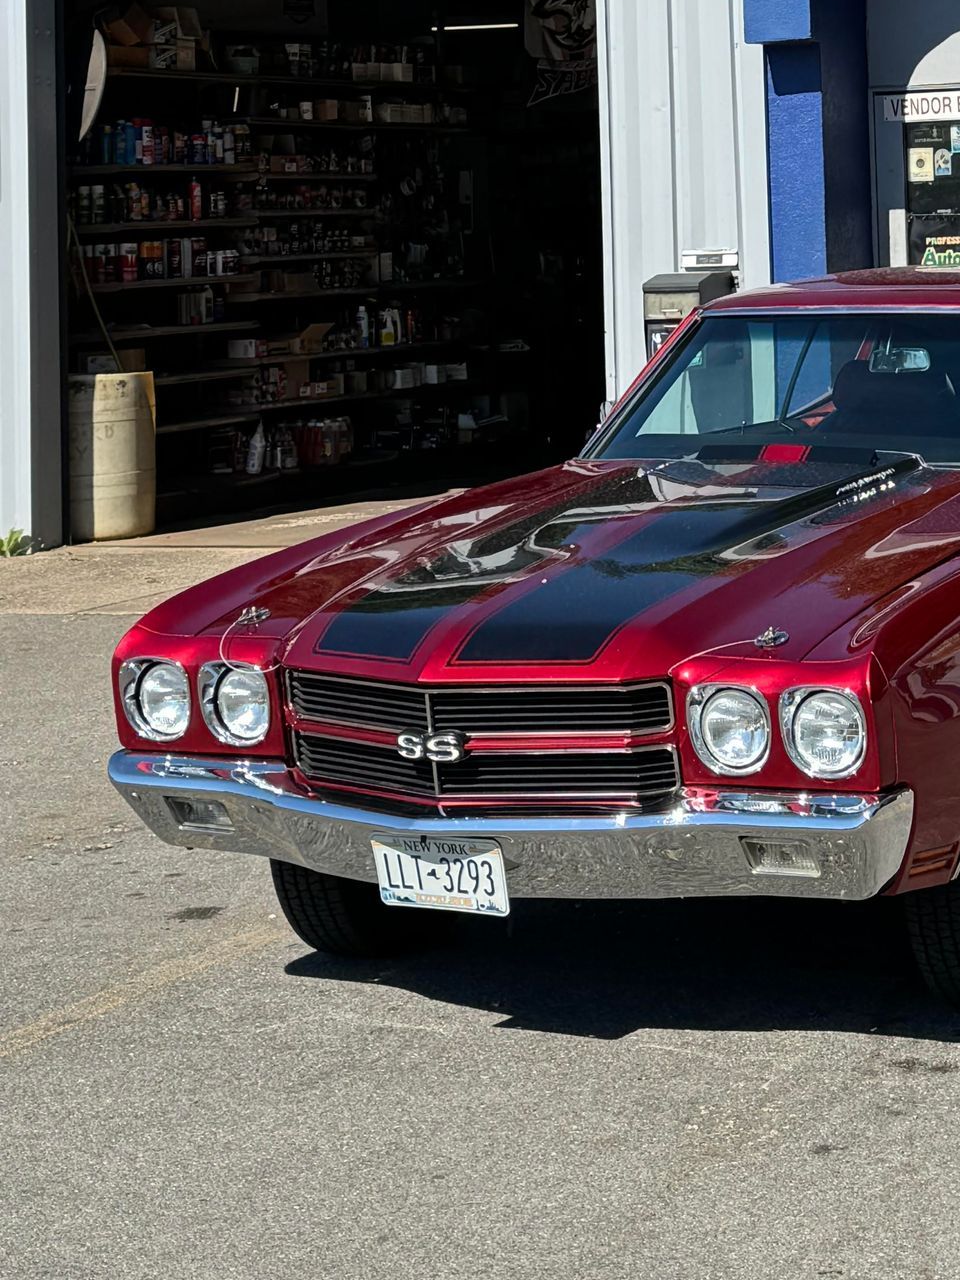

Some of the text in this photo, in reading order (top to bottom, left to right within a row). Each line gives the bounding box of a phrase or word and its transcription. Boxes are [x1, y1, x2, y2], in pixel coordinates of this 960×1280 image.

[890, 96, 952, 117] VENDOR
[396, 732, 463, 763] SS
[403, 839, 469, 856] NEW YORK
[383, 853, 496, 897] LLT 3293
